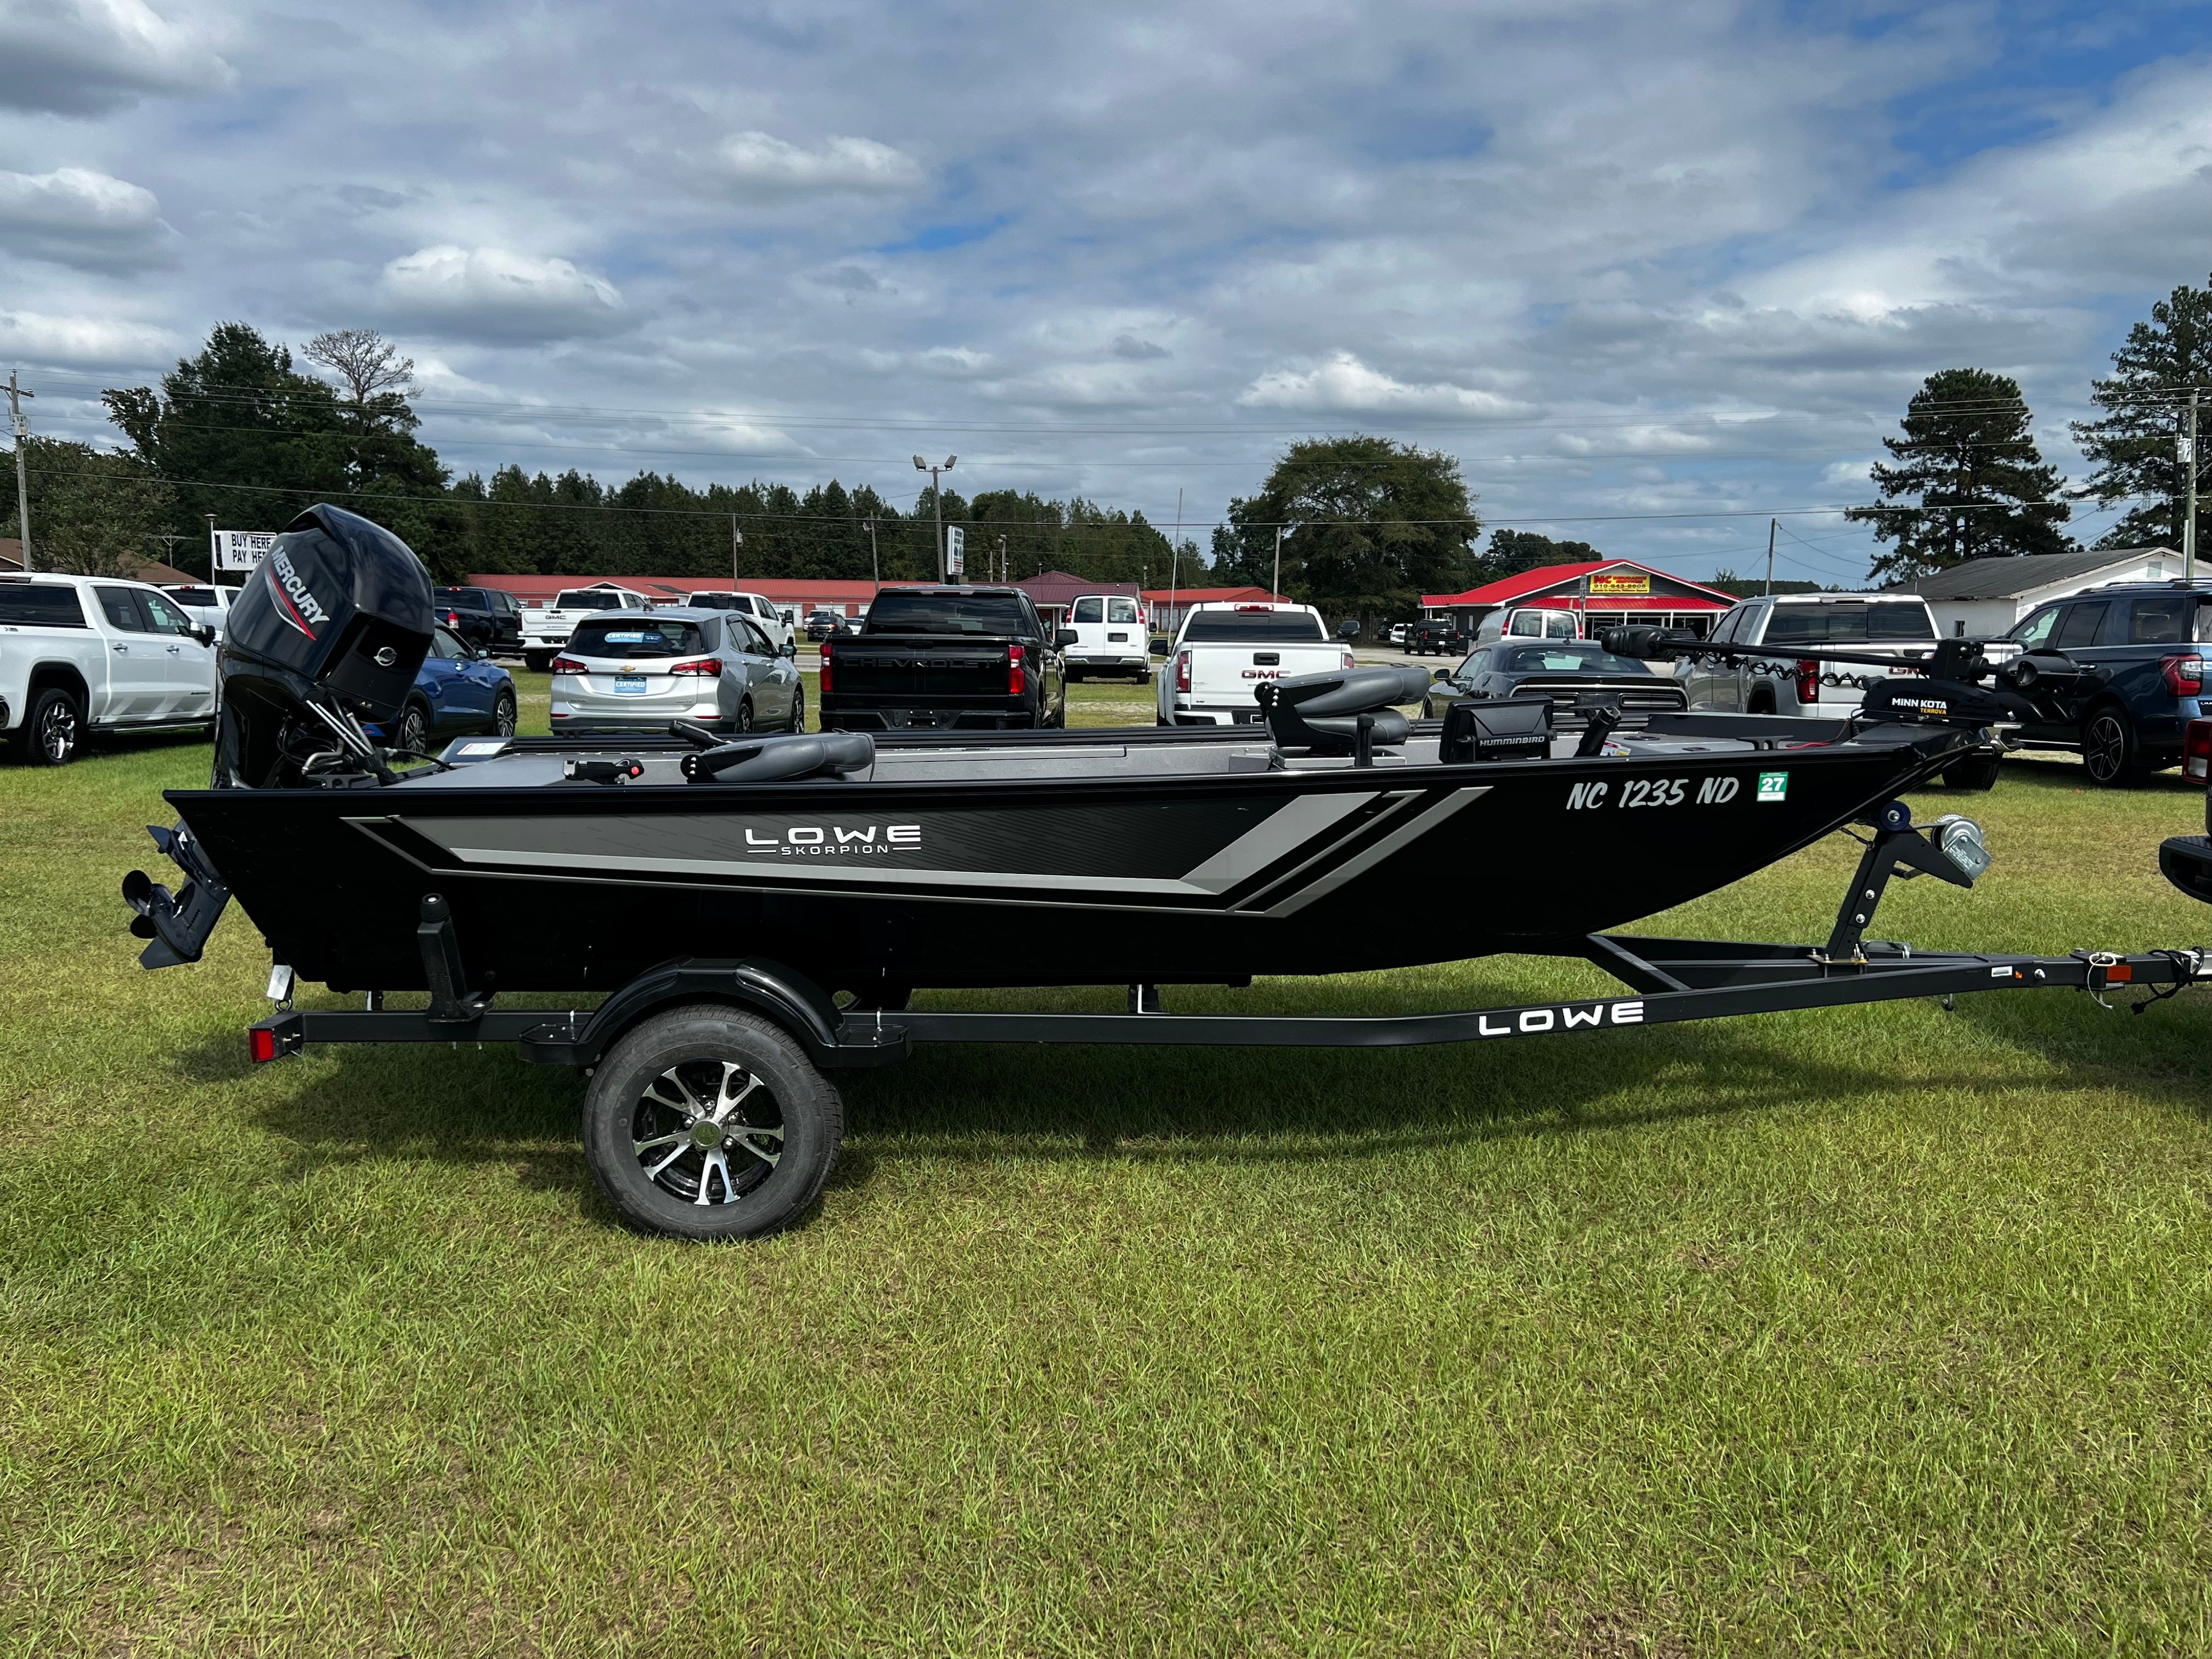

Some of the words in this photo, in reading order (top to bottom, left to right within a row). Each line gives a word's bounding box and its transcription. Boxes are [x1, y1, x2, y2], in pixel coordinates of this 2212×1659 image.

[232, 534, 247, 548] BUY
[251, 537, 270, 549] HERE
[233, 549, 247, 563] PAY
[251, 550, 266, 564] HE
[271, 545, 330, 624] MERCURY
[1593, 575, 1612, 584] NC
[844, 658, 997, 668] CHEVROLET
[1242, 670, 1291, 679] GMC
[1892, 697, 1919, 707] MINN
[1920, 699, 1947, 709] KOTA
[1479, 736, 1545, 746] HUMMINBIRD
[1760, 777, 1785, 791] 27
[1566, 782, 1608, 810] NC
[1618, 779, 1689, 808] 1235
[1696, 777, 1739, 804] ND
[744, 825, 922, 845] LOWE
[781, 845, 888, 856] SKORPION
[1479, 1001, 1644, 1036] LOWE
